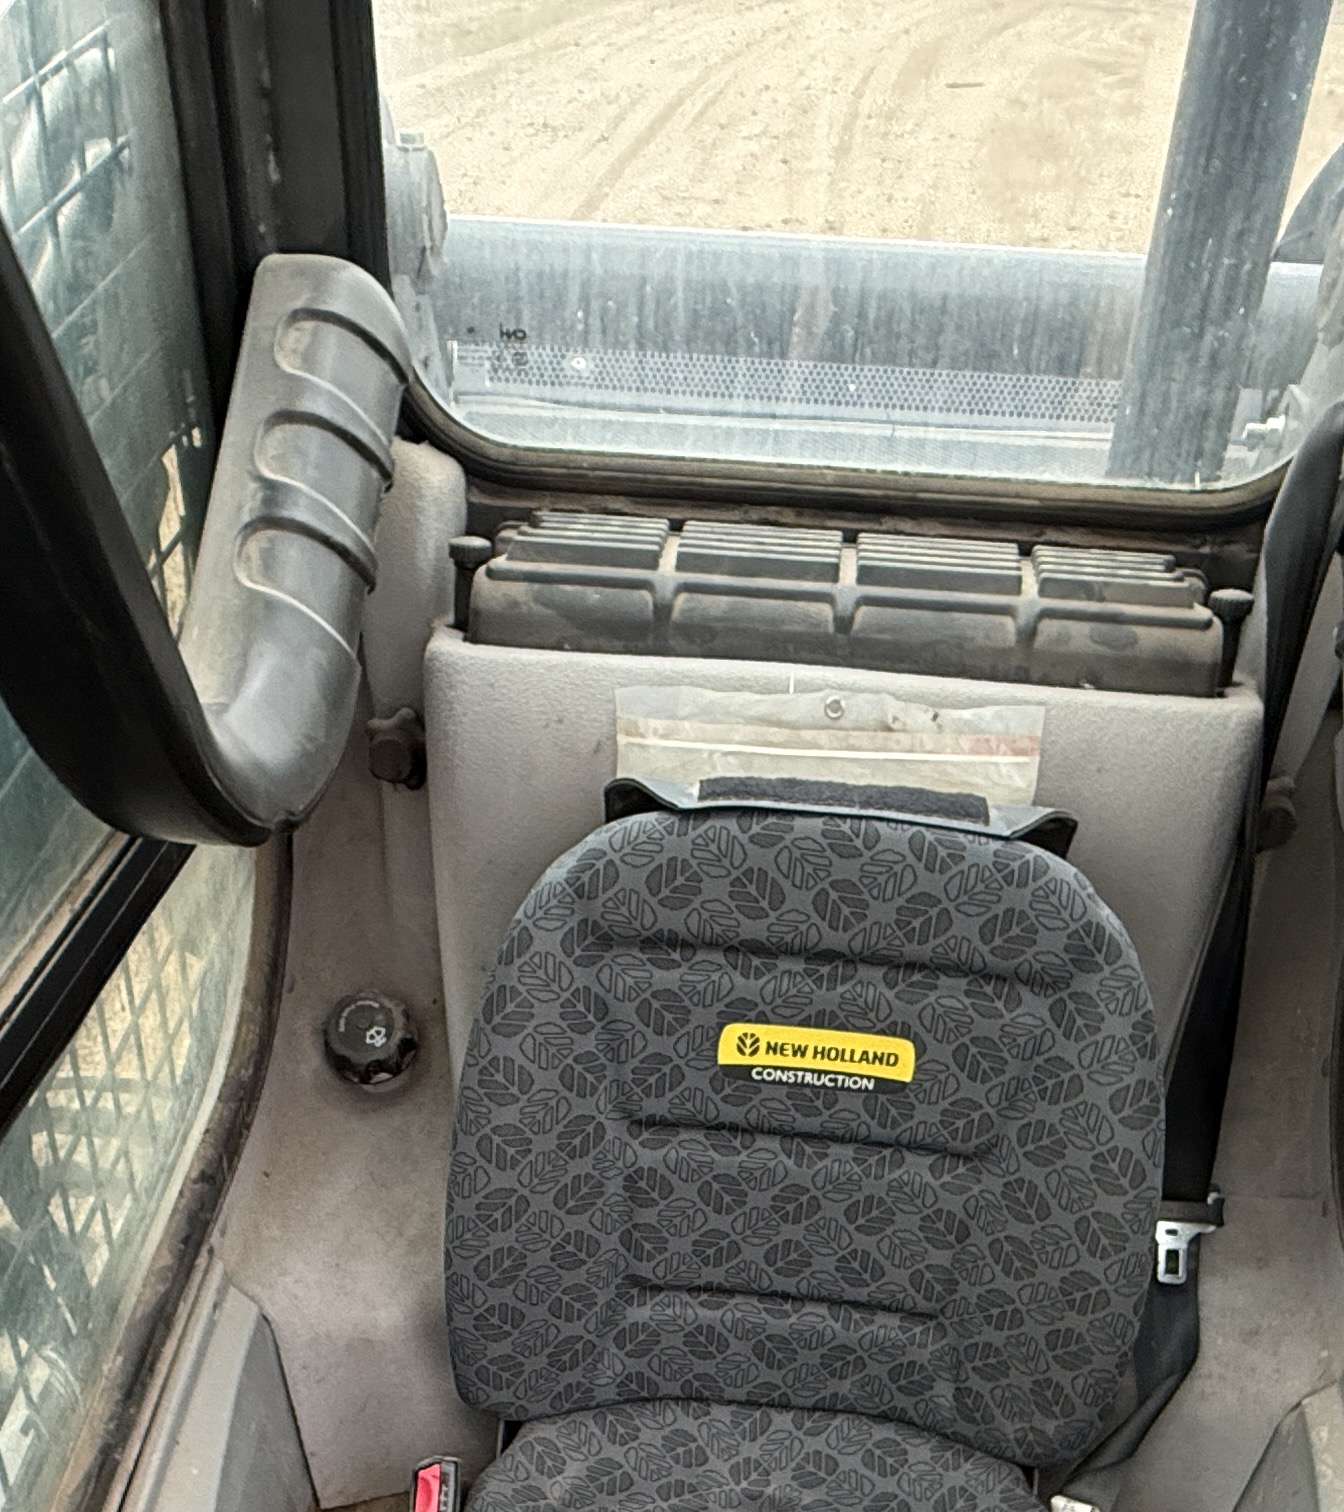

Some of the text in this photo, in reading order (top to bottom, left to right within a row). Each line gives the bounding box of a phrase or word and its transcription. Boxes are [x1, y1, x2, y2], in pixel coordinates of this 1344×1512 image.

[765, 1040, 899, 1067] NEW HOLLAND
[751, 1067, 875, 1090] CONSTRUCTION
